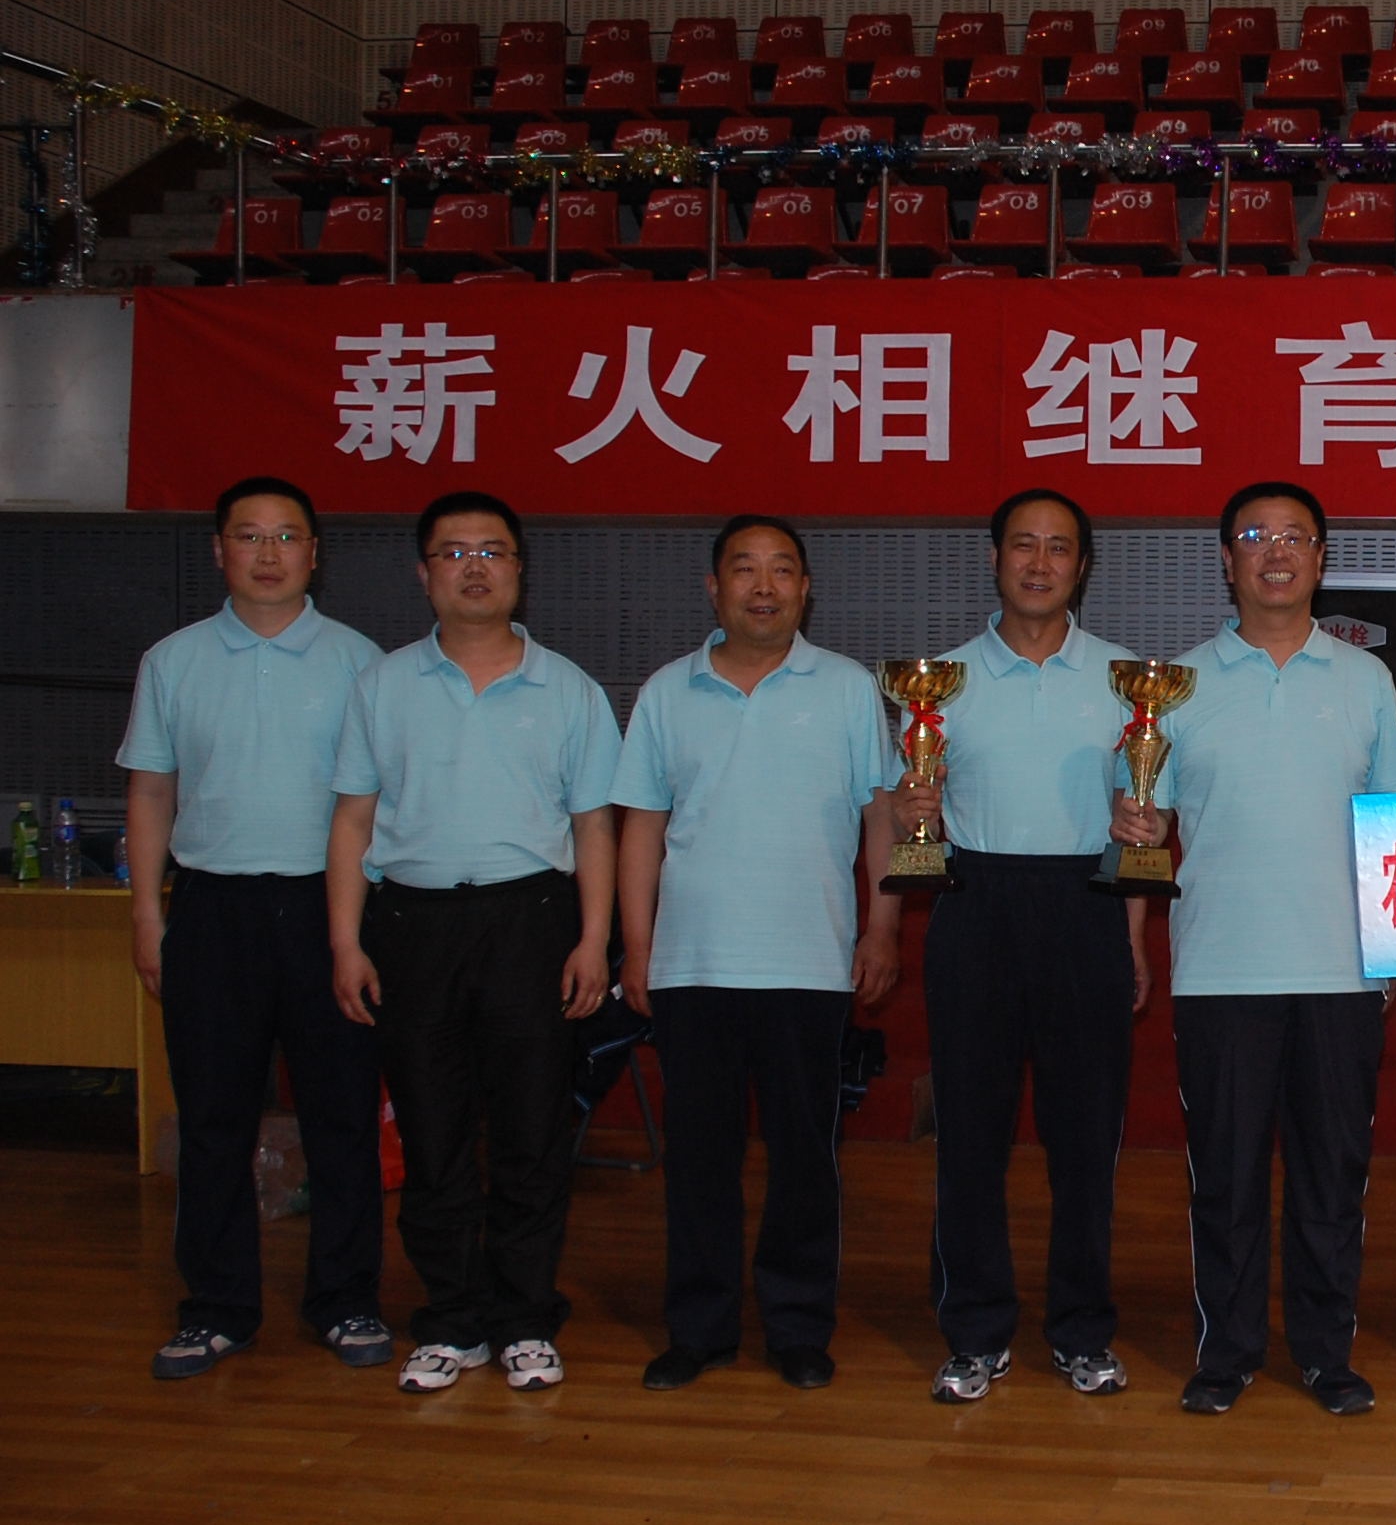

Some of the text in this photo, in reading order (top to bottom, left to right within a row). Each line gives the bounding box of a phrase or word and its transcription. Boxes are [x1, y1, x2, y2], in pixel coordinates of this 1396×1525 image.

[1051, 20, 1074, 32] 08
[1142, 19, 1165, 30] 09
[1238, 17, 1255, 28] 10
[1331, 15, 1343, 26] 11
[608, 28, 630, 41] 03
[781, 26, 803, 38] 05
[869, 24, 892, 37] 06
[960, 22, 983, 35] 07
[441, 31, 460, 43] 01
[523, 31, 544, 43] 02
[896, 65, 921, 78] 06
[997, 65, 1020, 77] 07
[1195, 60, 1221, 73] 09
[1300, 59, 1319, 72] 10
[432, 76, 453, 89] 01
[523, 74, 544, 86] 02
[950, 127, 976, 140] 07
[1161, 121, 1187, 134] 09
[1273, 120, 1294, 134] 10
[447, 134, 472, 148] 02
[541, 131, 566, 145] 03
[742, 128, 769, 141] 05
[349, 137, 370, 149] 01
[783, 200, 812, 214] 06
[894, 197, 923, 214] 07
[1010, 195, 1038, 209] 08
[1122, 194, 1152, 209] 09
[1243, 195, 1265, 209] 10
[1360, 196, 1376, 211] 11
[254, 209, 278, 223] 01
[358, 208, 384, 221] 02
[462, 205, 488, 218] 03
[568, 204, 596, 217] 04
[674, 202, 702, 217] 05
[1319, 623, 1368, 645] 火栓
